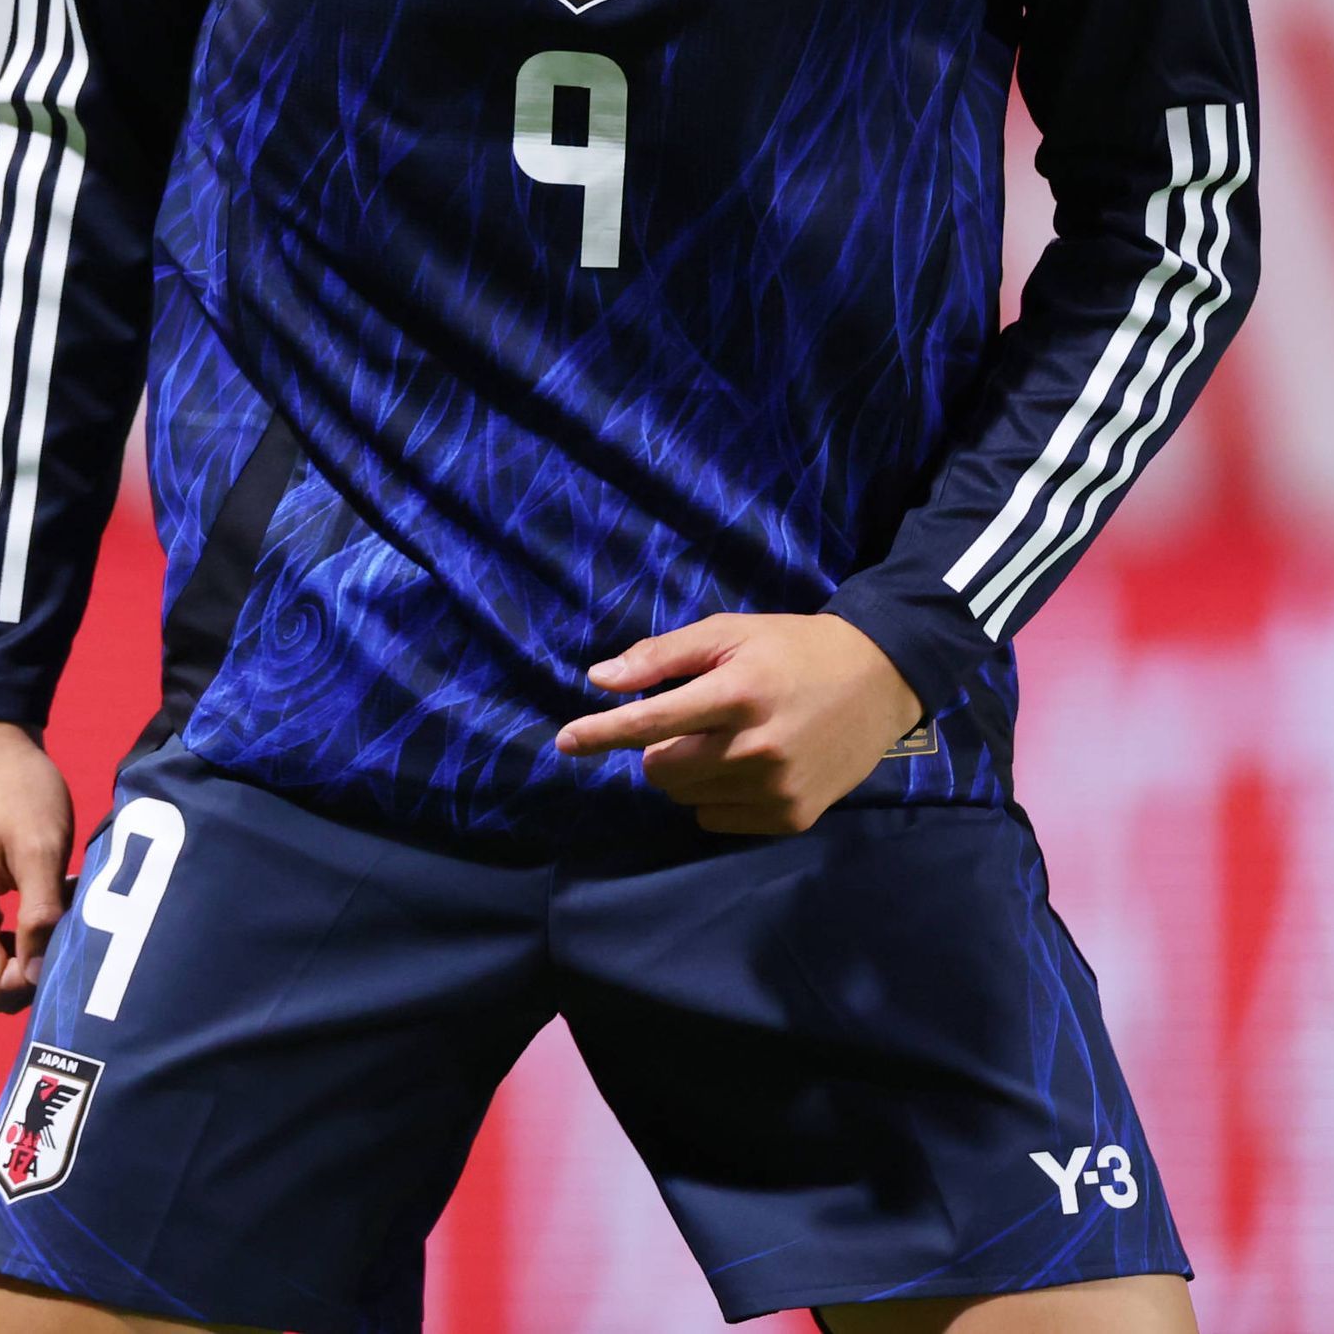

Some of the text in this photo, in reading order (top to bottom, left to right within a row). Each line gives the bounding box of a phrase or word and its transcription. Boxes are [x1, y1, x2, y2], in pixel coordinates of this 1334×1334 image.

[513, 50, 628, 268] 9
[82, 797, 186, 1021] 9
[37, 1052, 79, 1073] JAPAN
[3, 1148, 38, 1177] JFA
[1028, 1144, 1139, 1215] Y-3
